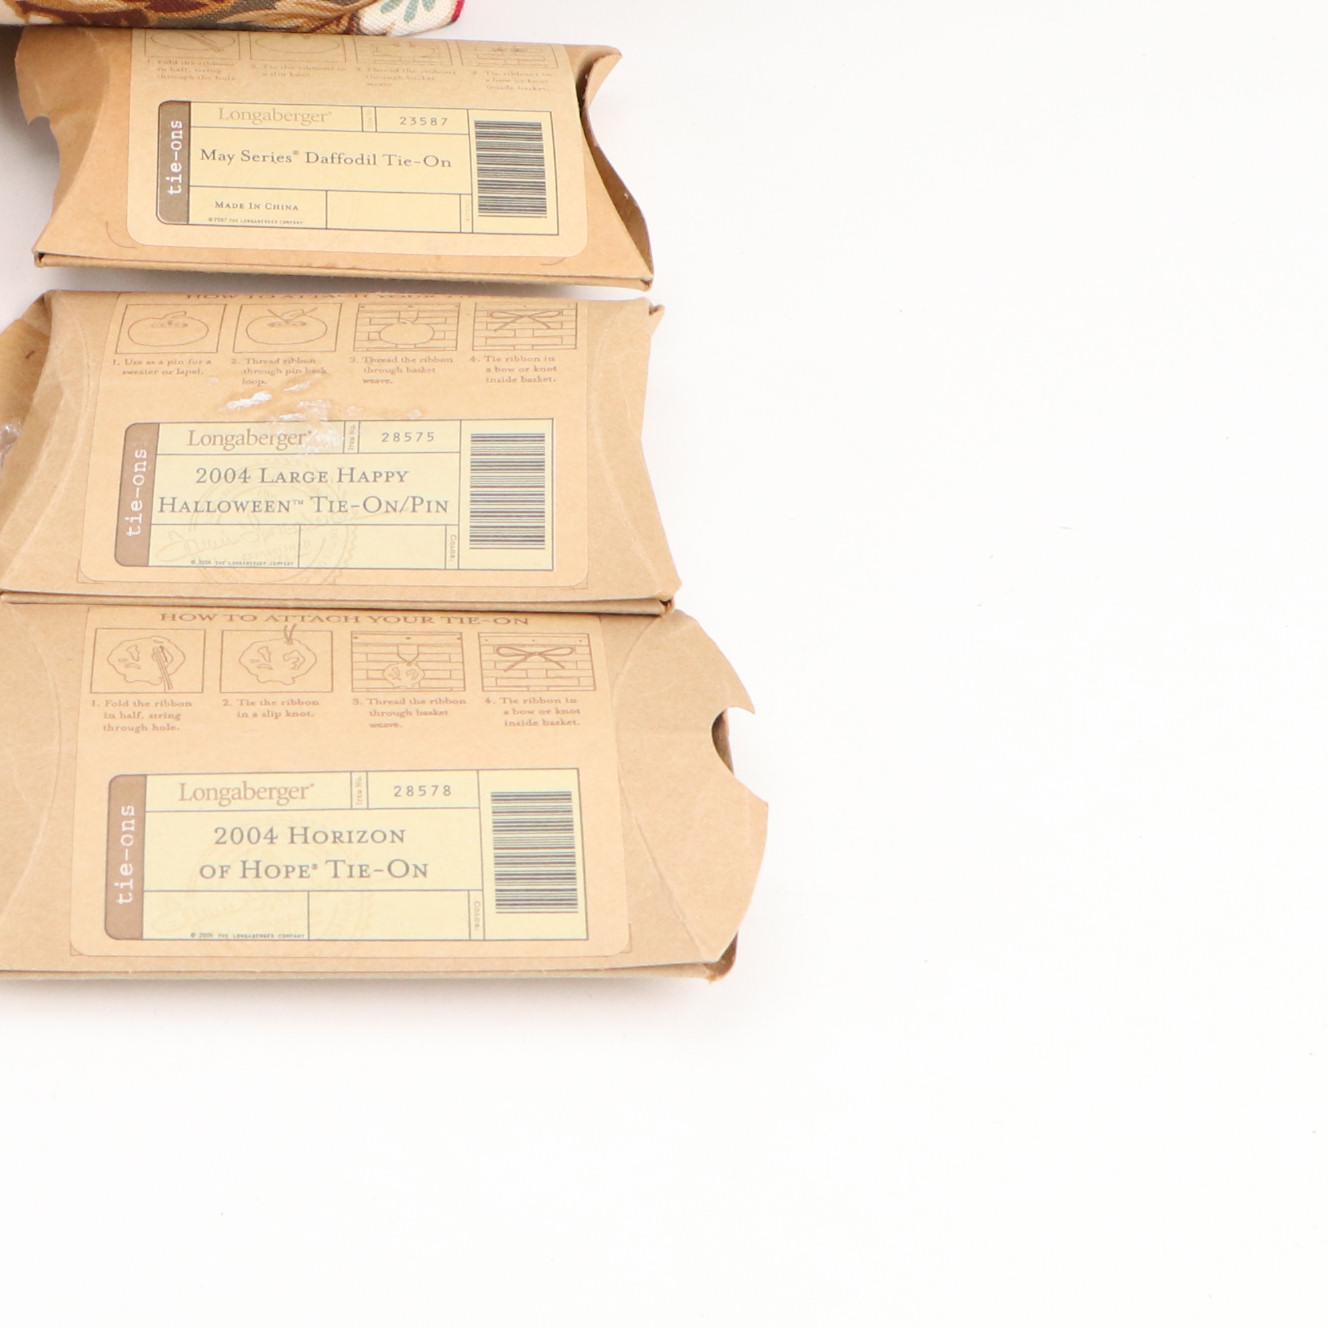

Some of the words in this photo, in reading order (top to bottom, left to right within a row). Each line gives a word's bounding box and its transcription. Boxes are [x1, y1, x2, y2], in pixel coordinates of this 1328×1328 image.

[399, 115, 450, 127] 23587
[166, 119, 184, 196] tie-ons
[200, 148, 235, 166] May
[241, 148, 300, 165] Series®
[305, 150, 378, 167] Daffodil
[382, 153, 452, 170] Tie-On
[214, 200, 247, 210] MADE
[249, 201, 262, 210] IN
[264, 202, 299, 211] CHINA
[381, 431, 436, 443] 28575
[195, 467, 252, 485] 2004
[259, 467, 329, 484] LARGE
[336, 467, 409, 484] HAPPY
[126, 448, 148, 537] tie-ons
[158, 496, 305, 514] HALLOWEEN™
[309, 495, 449, 515] TIE-ON/PIN
[160, 612, 218, 623] HOW
[223, 613, 257, 623] TO
[264, 613, 360, 624] ATTACH
[366, 614, 434, 624] YOUR
[440, 615, 529, 626] TIE-ON
[393, 785, 452, 798] 28578
[214, 826, 278, 845] 2004
[289, 826, 406, 845] HORIZON
[117, 804, 137, 905] tie-ons
[199, 863, 230, 880] OF
[239, 859, 318, 880] HOPE®
[326, 859, 429, 880] TIE-ON
